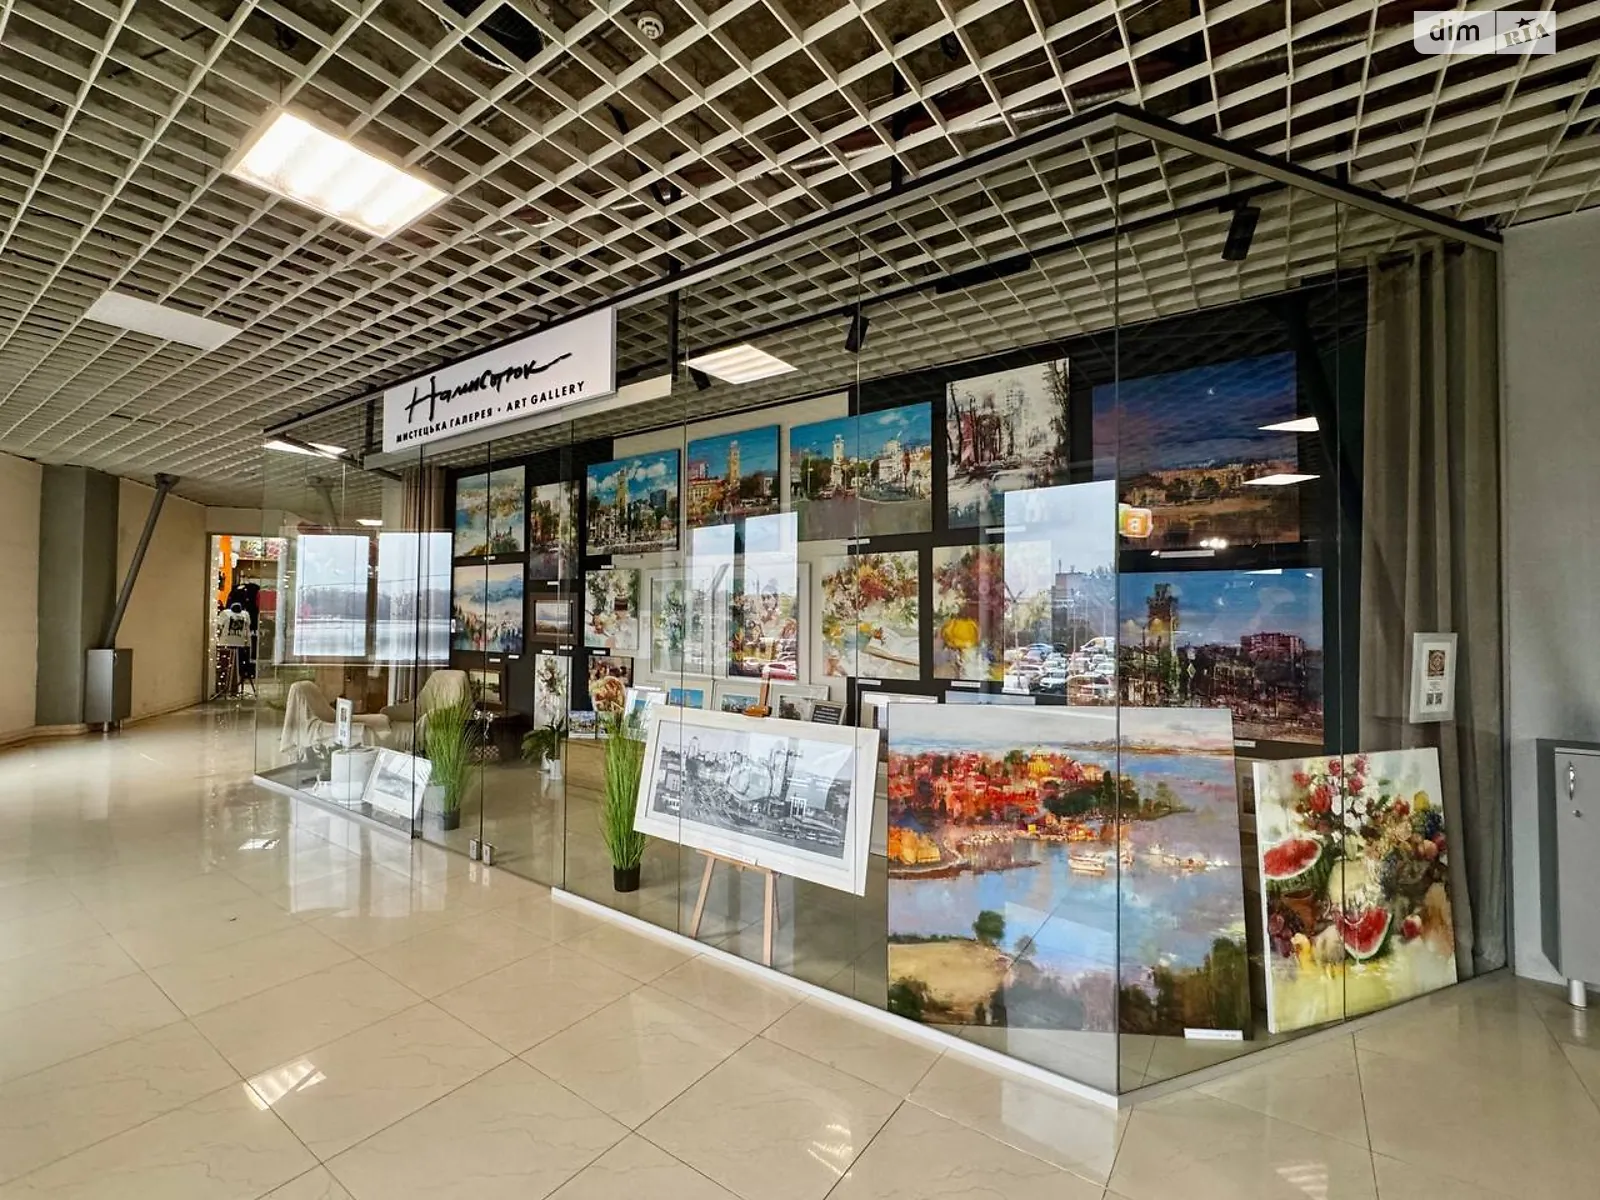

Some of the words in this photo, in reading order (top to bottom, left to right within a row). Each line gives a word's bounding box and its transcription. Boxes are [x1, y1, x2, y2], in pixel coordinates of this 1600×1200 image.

[396, 421, 447, 443] МИСТЕЦЬКА
[449, 407, 492, 428] ГАЛЕРЕЯ
[506, 397, 527, 412] ART
[530, 381, 585, 405] GALLERY
